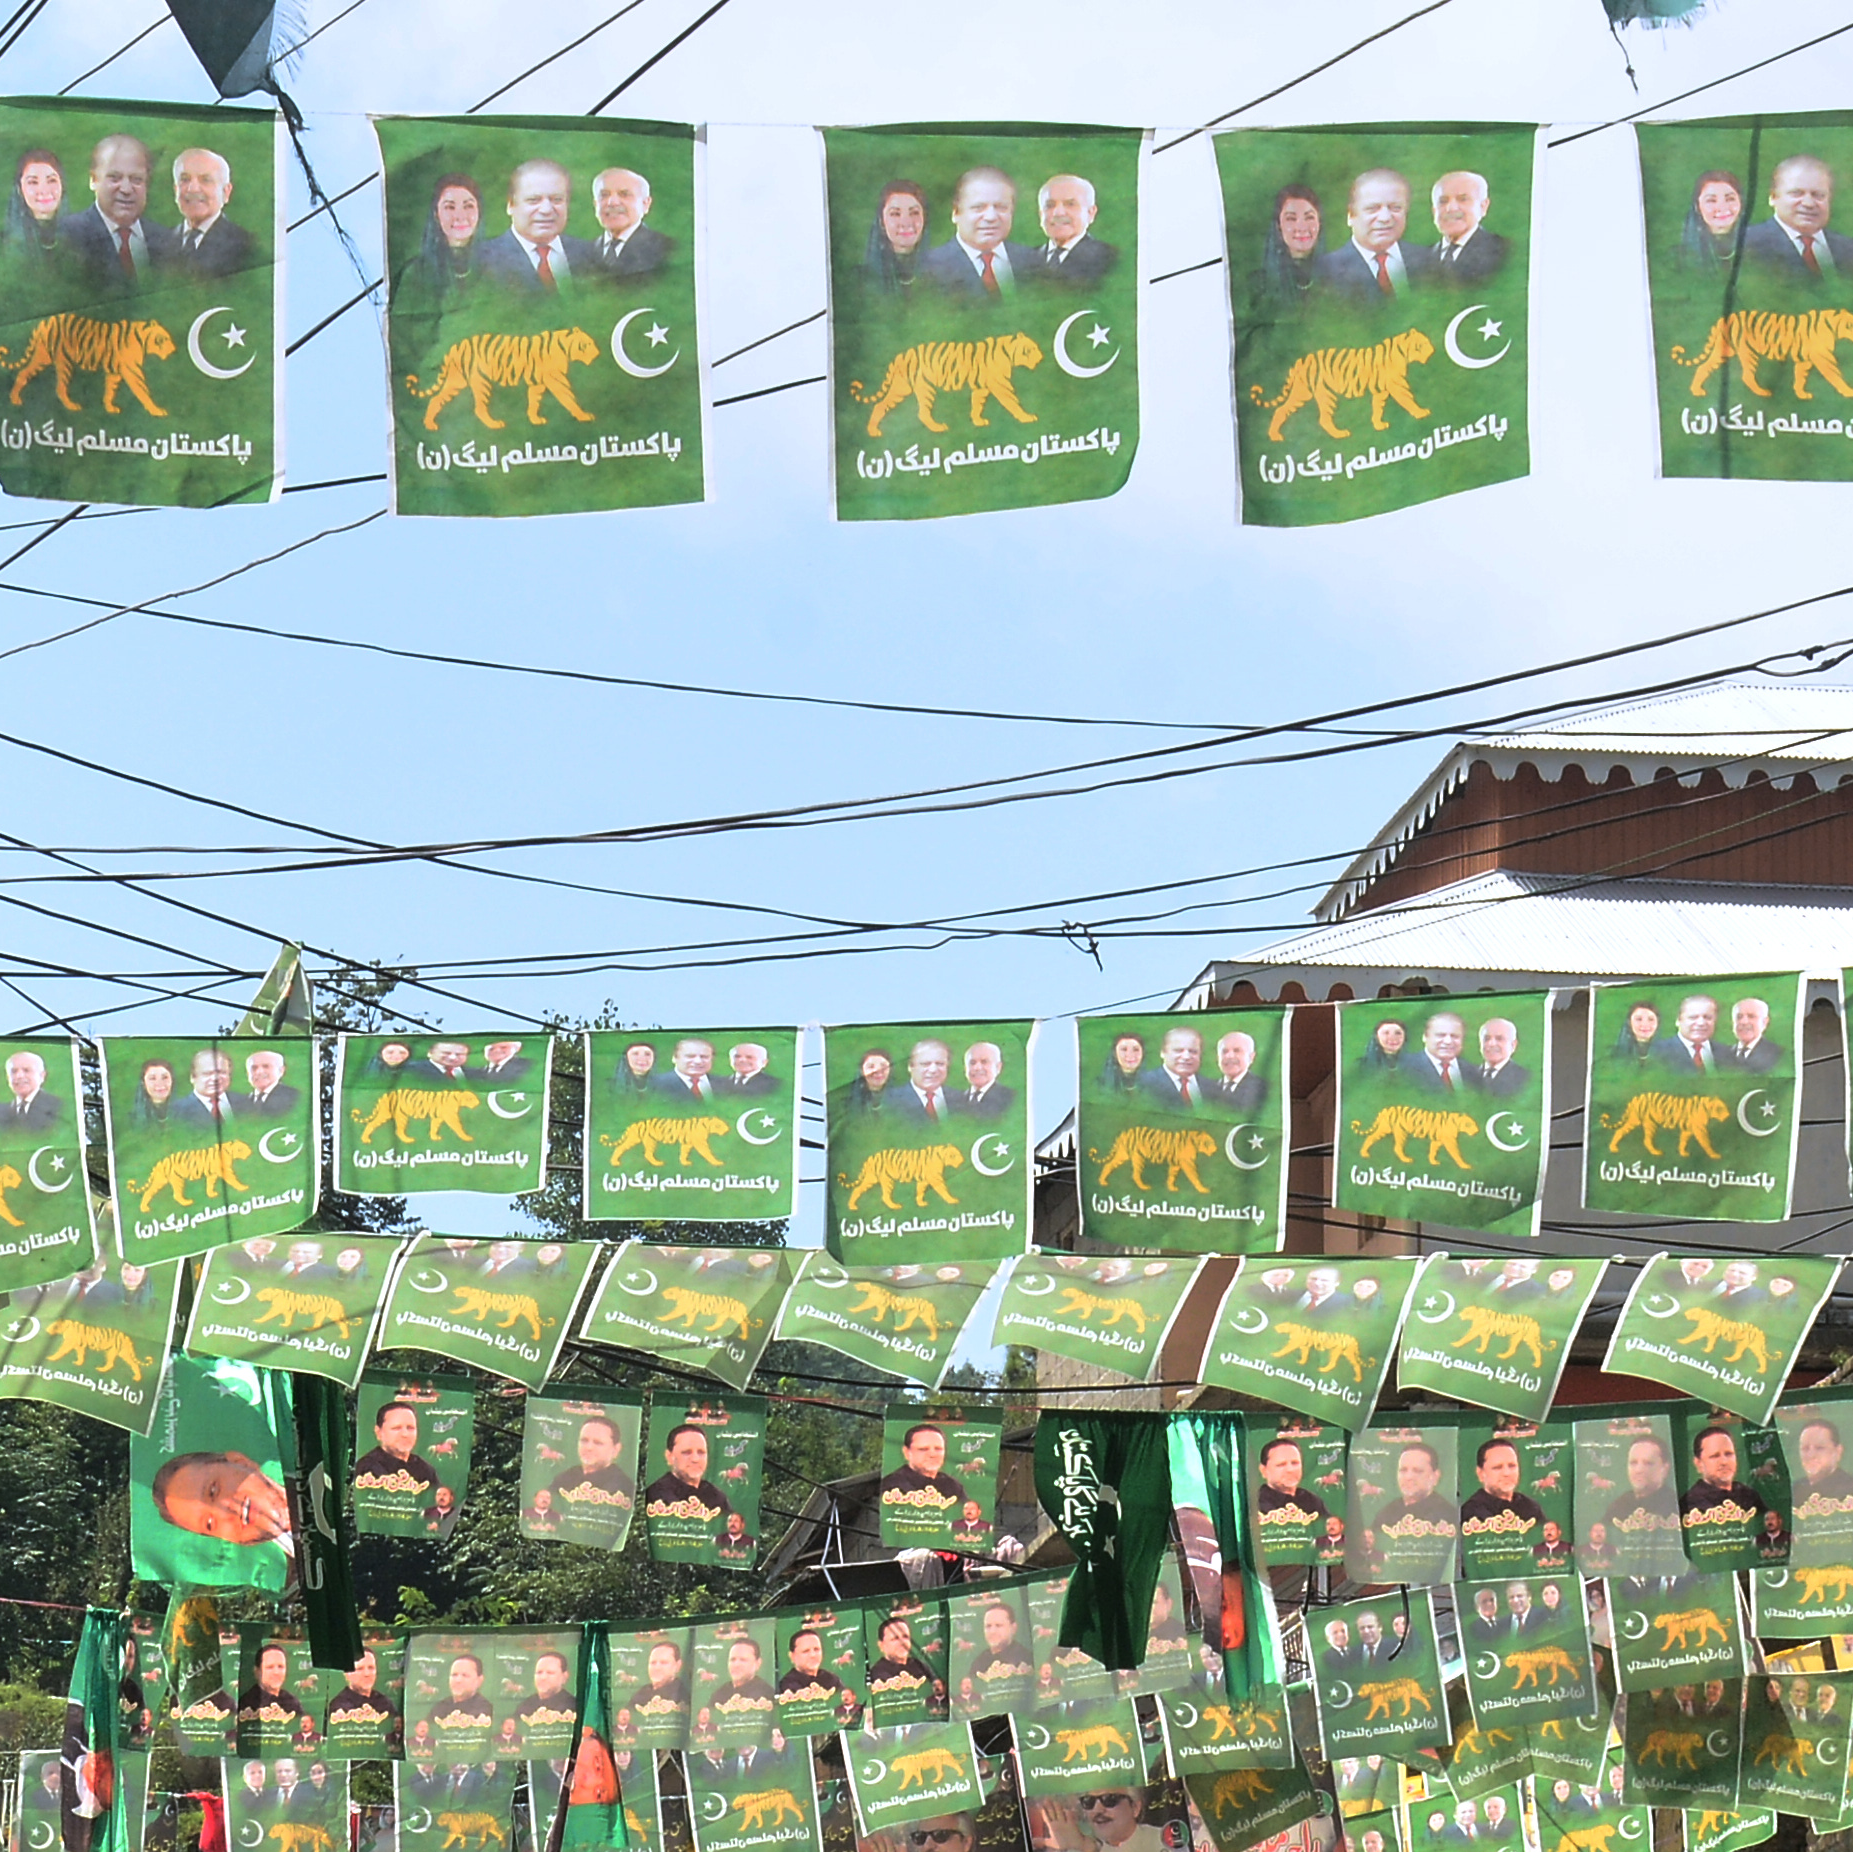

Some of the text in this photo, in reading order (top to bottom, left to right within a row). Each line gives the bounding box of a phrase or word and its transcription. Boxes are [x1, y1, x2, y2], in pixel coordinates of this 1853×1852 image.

[1720, 403, 1765, 437] لیگ
[1767, 412, 1844, 438] مسلم
[1020, 427, 1121, 464] پاکستان
[1417, 413, 1510, 460] پاکستان
[894, 443, 941, 476] لیگ
[943, 442, 1020, 475] مسلم
[1296, 448, 1343, 482] لیگ
[1345, 442, 1417, 479] مسلم
[1624, 1160, 1656, 1184] لیگ
[1656, 1166, 1707, 1186] مسلم
[1707, 1169, 1776, 1193] پاکستان
[1114, 1194, 1145, 1217] لیگ
[1145, 1200, 1197, 1219] مسلم
[1197, 1203, 1266, 1227] پاکستان
